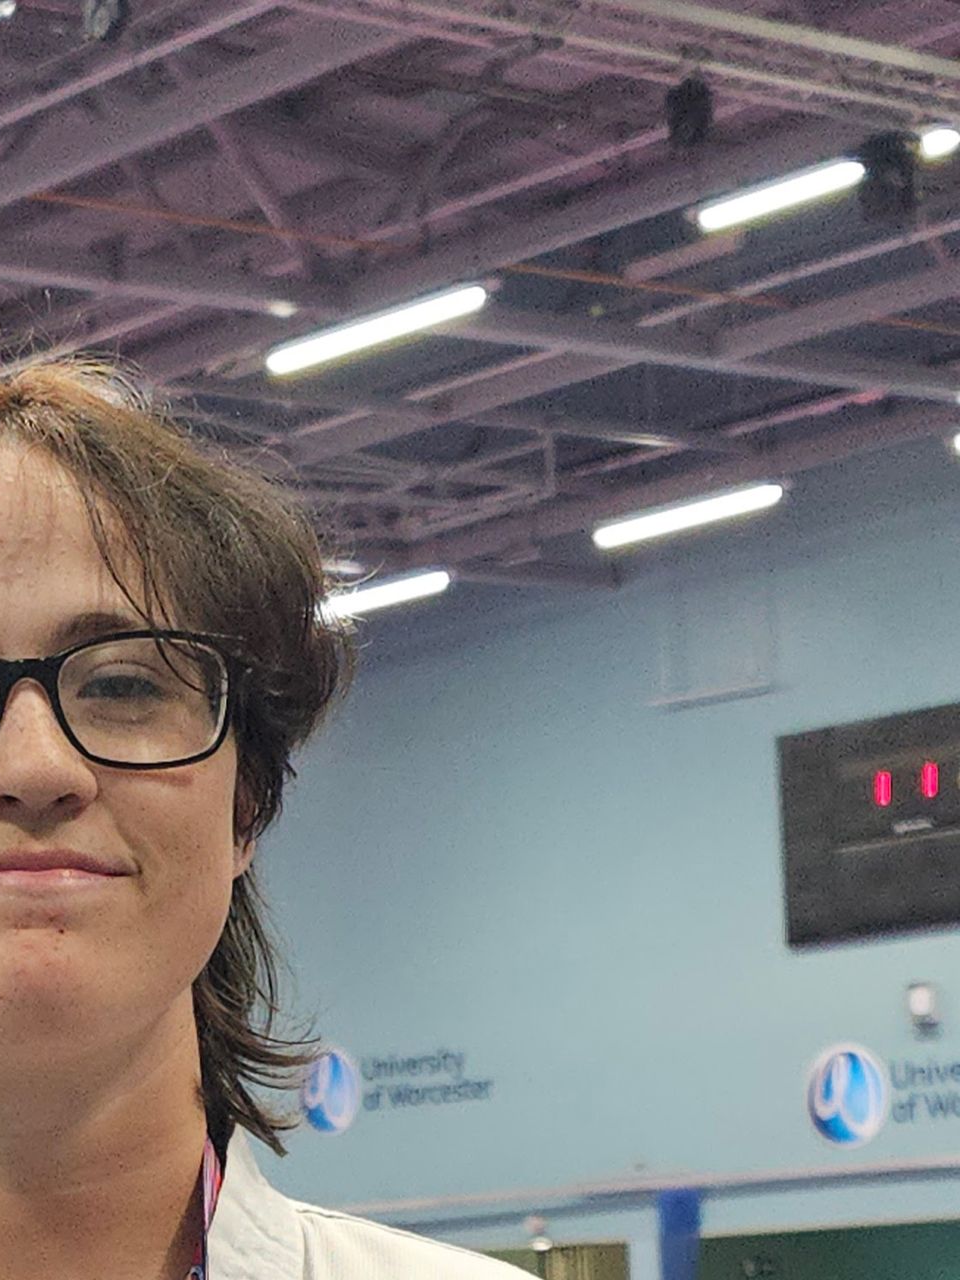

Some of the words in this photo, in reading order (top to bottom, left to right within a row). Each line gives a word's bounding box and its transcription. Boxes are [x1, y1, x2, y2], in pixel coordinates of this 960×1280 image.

[361, 1047, 464, 1081] University
[362, 1085, 383, 1111] of
[389, 1079, 493, 1109] Worcester
[893, 1092, 917, 1123] of
